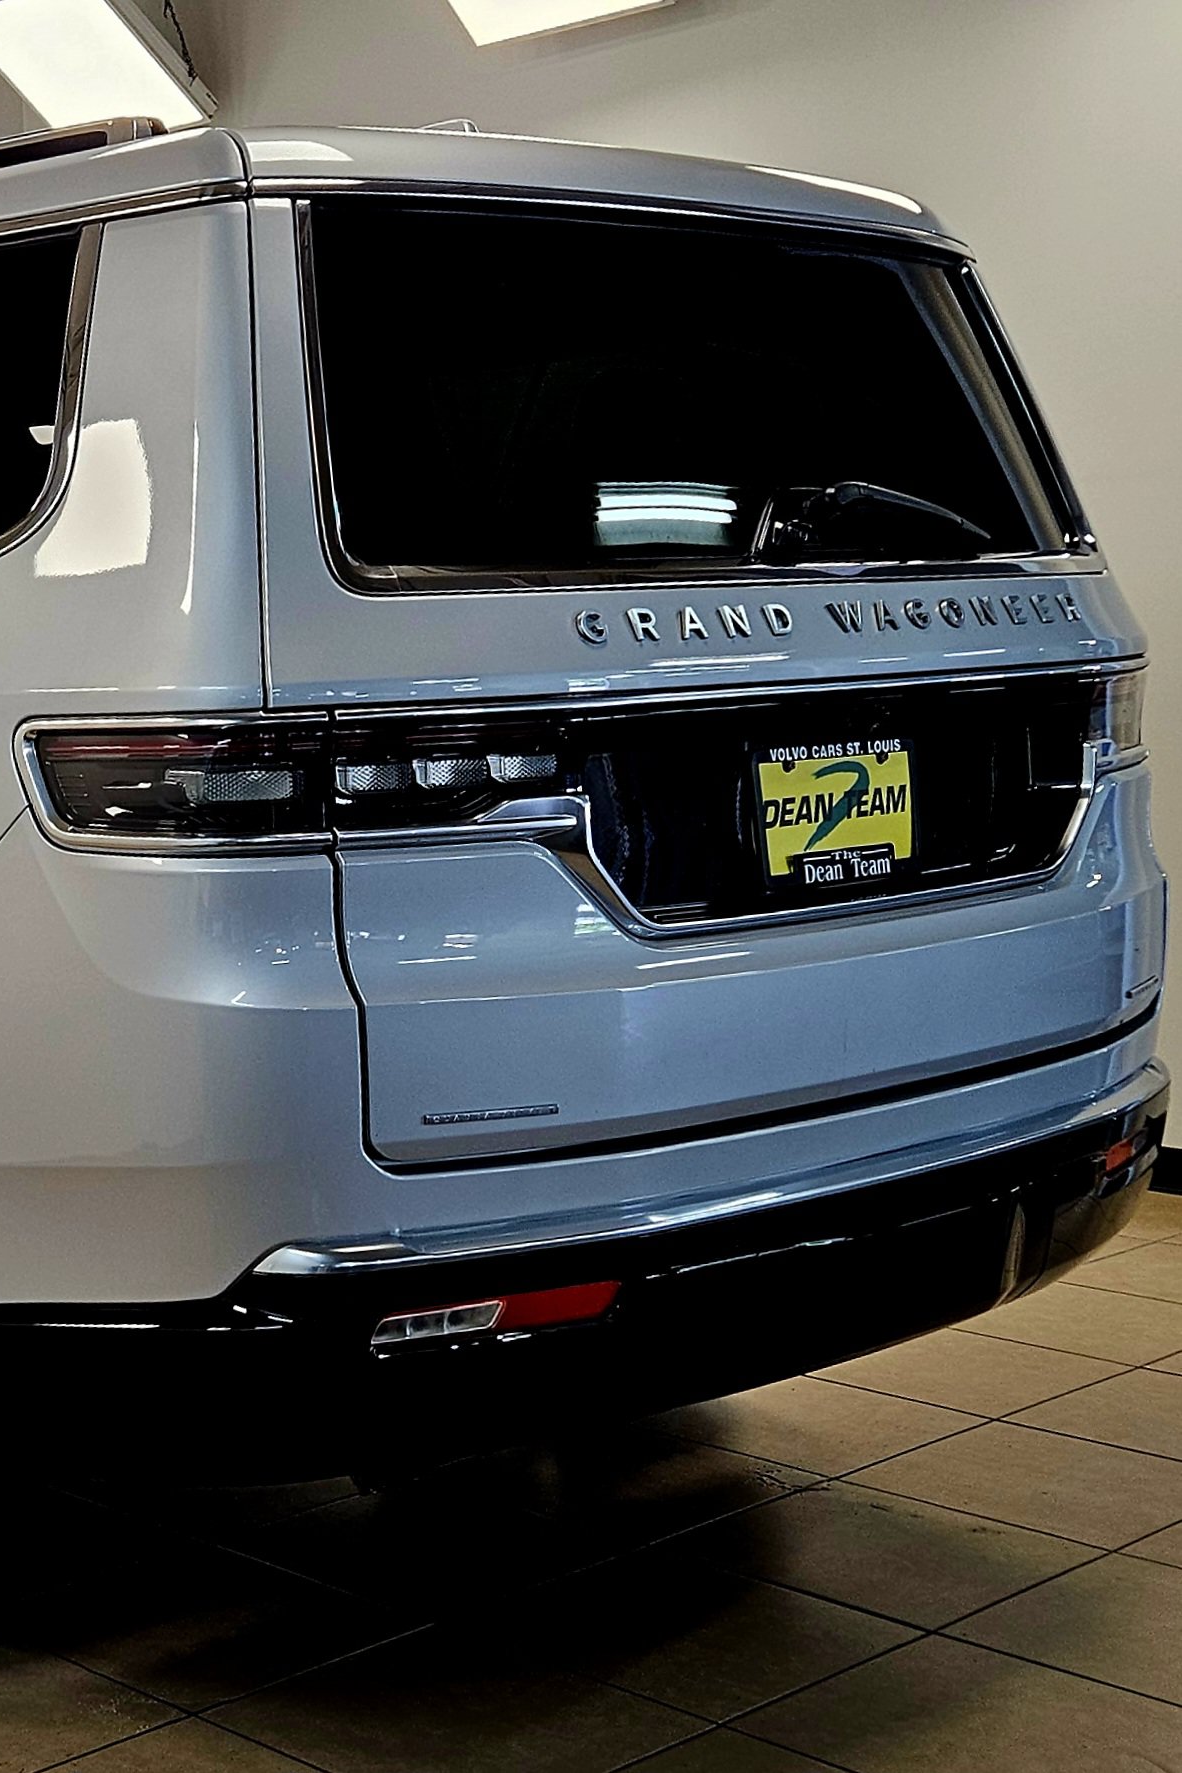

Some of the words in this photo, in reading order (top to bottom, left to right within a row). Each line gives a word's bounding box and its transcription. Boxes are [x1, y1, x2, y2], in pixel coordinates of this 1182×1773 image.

[575, 602, 794, 646] GRAND
[825, 592, 1083, 634] WAGONEER
[769, 745, 808, 762] VOLVO
[811, 743, 843, 759] CARS
[846, 741, 864, 755] ST.
[867, 738, 901, 754] LOUIS
[763, 792, 835, 830] DEAN
[843, 783, 908, 820] TEAM
[830, 850, 862, 861] The
[803, 861, 844, 884] Dean
[850, 857, 892, 878] Team
